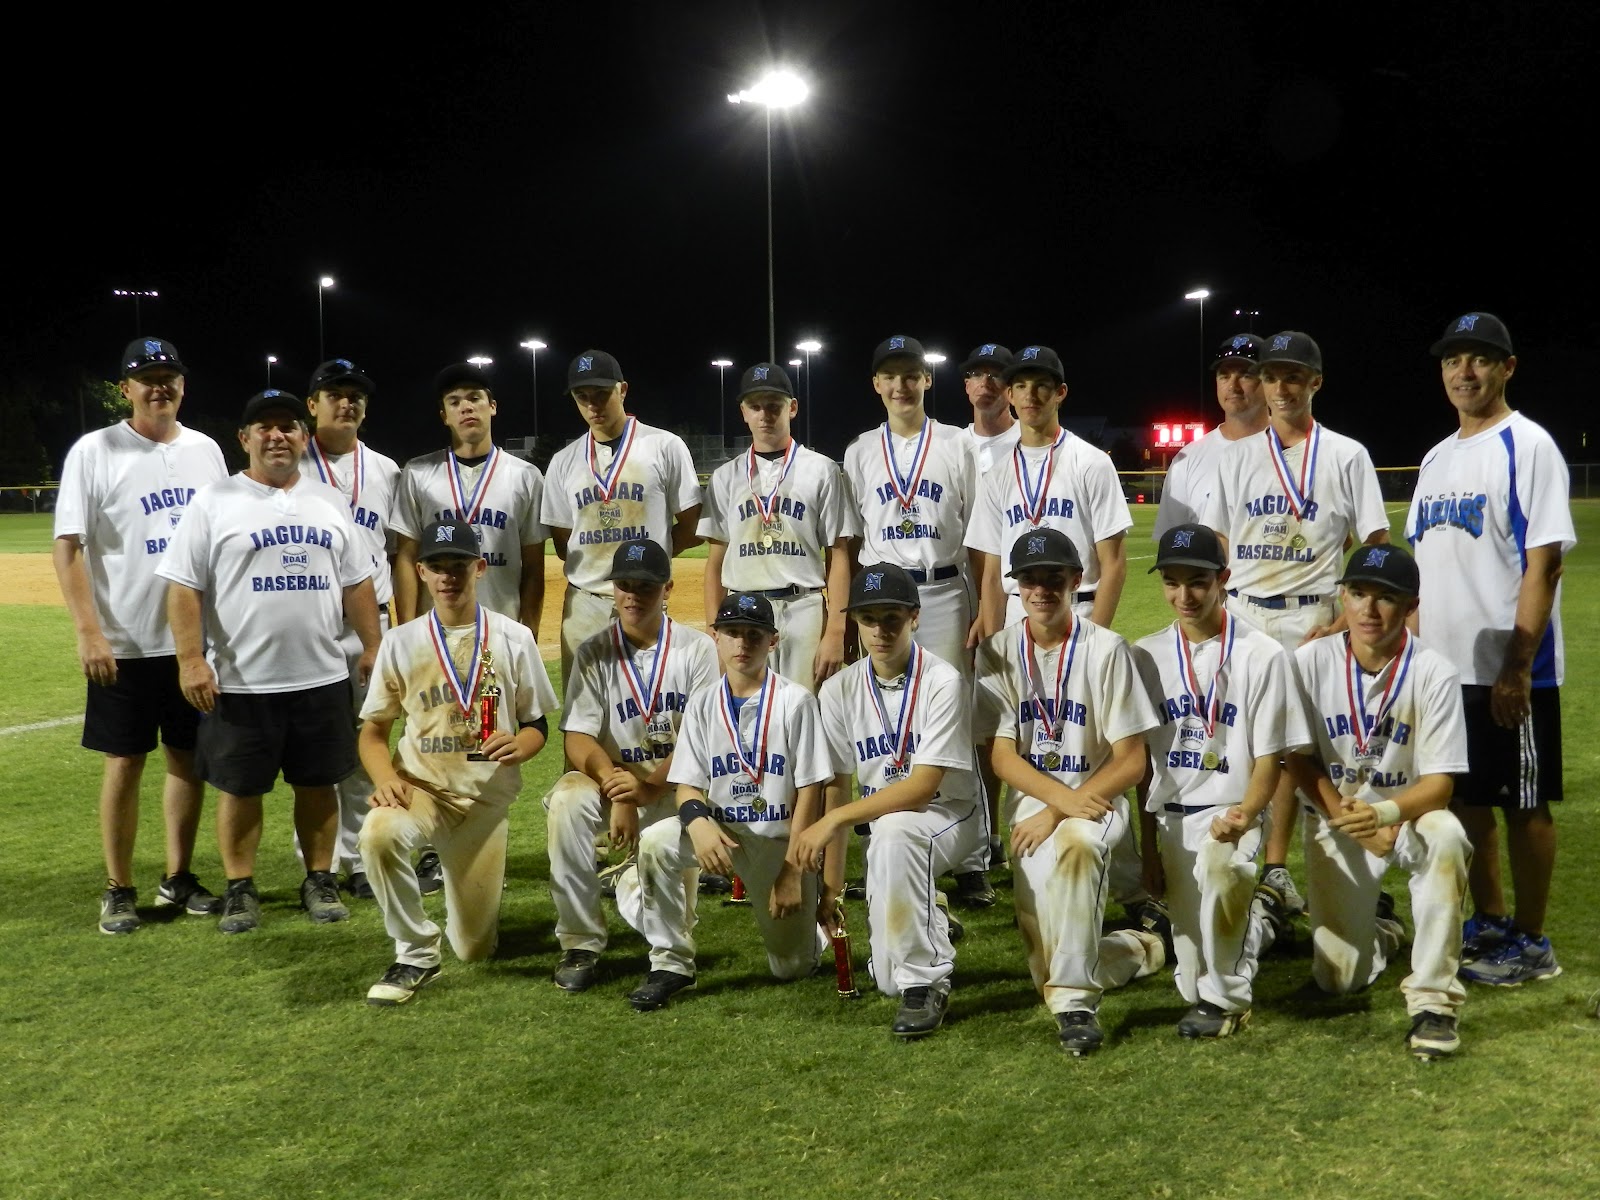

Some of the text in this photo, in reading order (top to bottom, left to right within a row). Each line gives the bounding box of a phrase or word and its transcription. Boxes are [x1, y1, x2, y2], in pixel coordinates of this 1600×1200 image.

[435, 526, 455, 542] N
[580, 526, 649, 545] BASEBALL
[1264, 525, 1287, 534] NOAH
[250, 525, 333, 550] JAGUAR
[282, 554, 307, 564] NOAH
[252, 575, 331, 592] BASEBALL
[648, 722, 671, 733] NOAH
[1181, 729, 1204, 740] NOAH
[732, 783, 759, 795] NOAH
